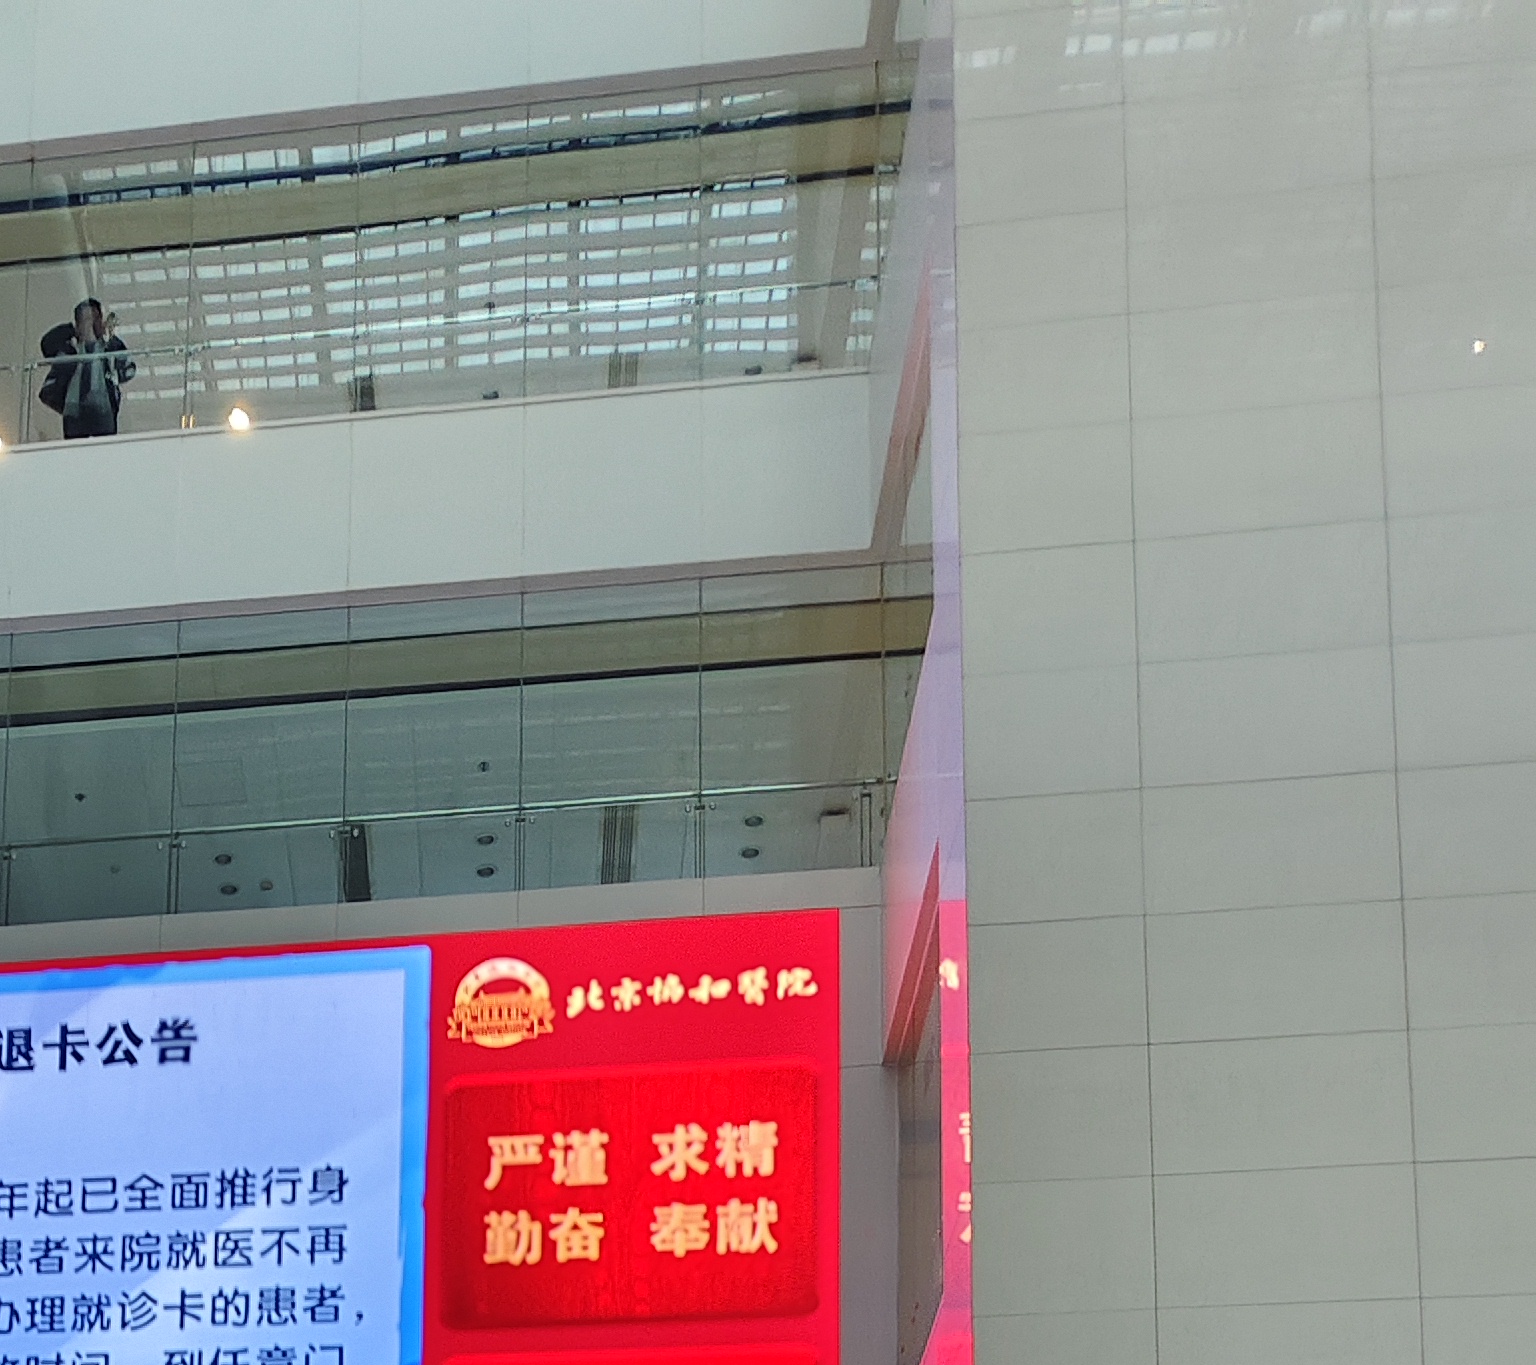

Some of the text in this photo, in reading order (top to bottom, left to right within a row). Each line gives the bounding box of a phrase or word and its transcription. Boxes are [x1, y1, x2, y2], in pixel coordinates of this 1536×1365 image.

[483, 1120, 779, 1190] 严谨 求精
[482, 1196, 780, 1266] 勤奋 奉献
